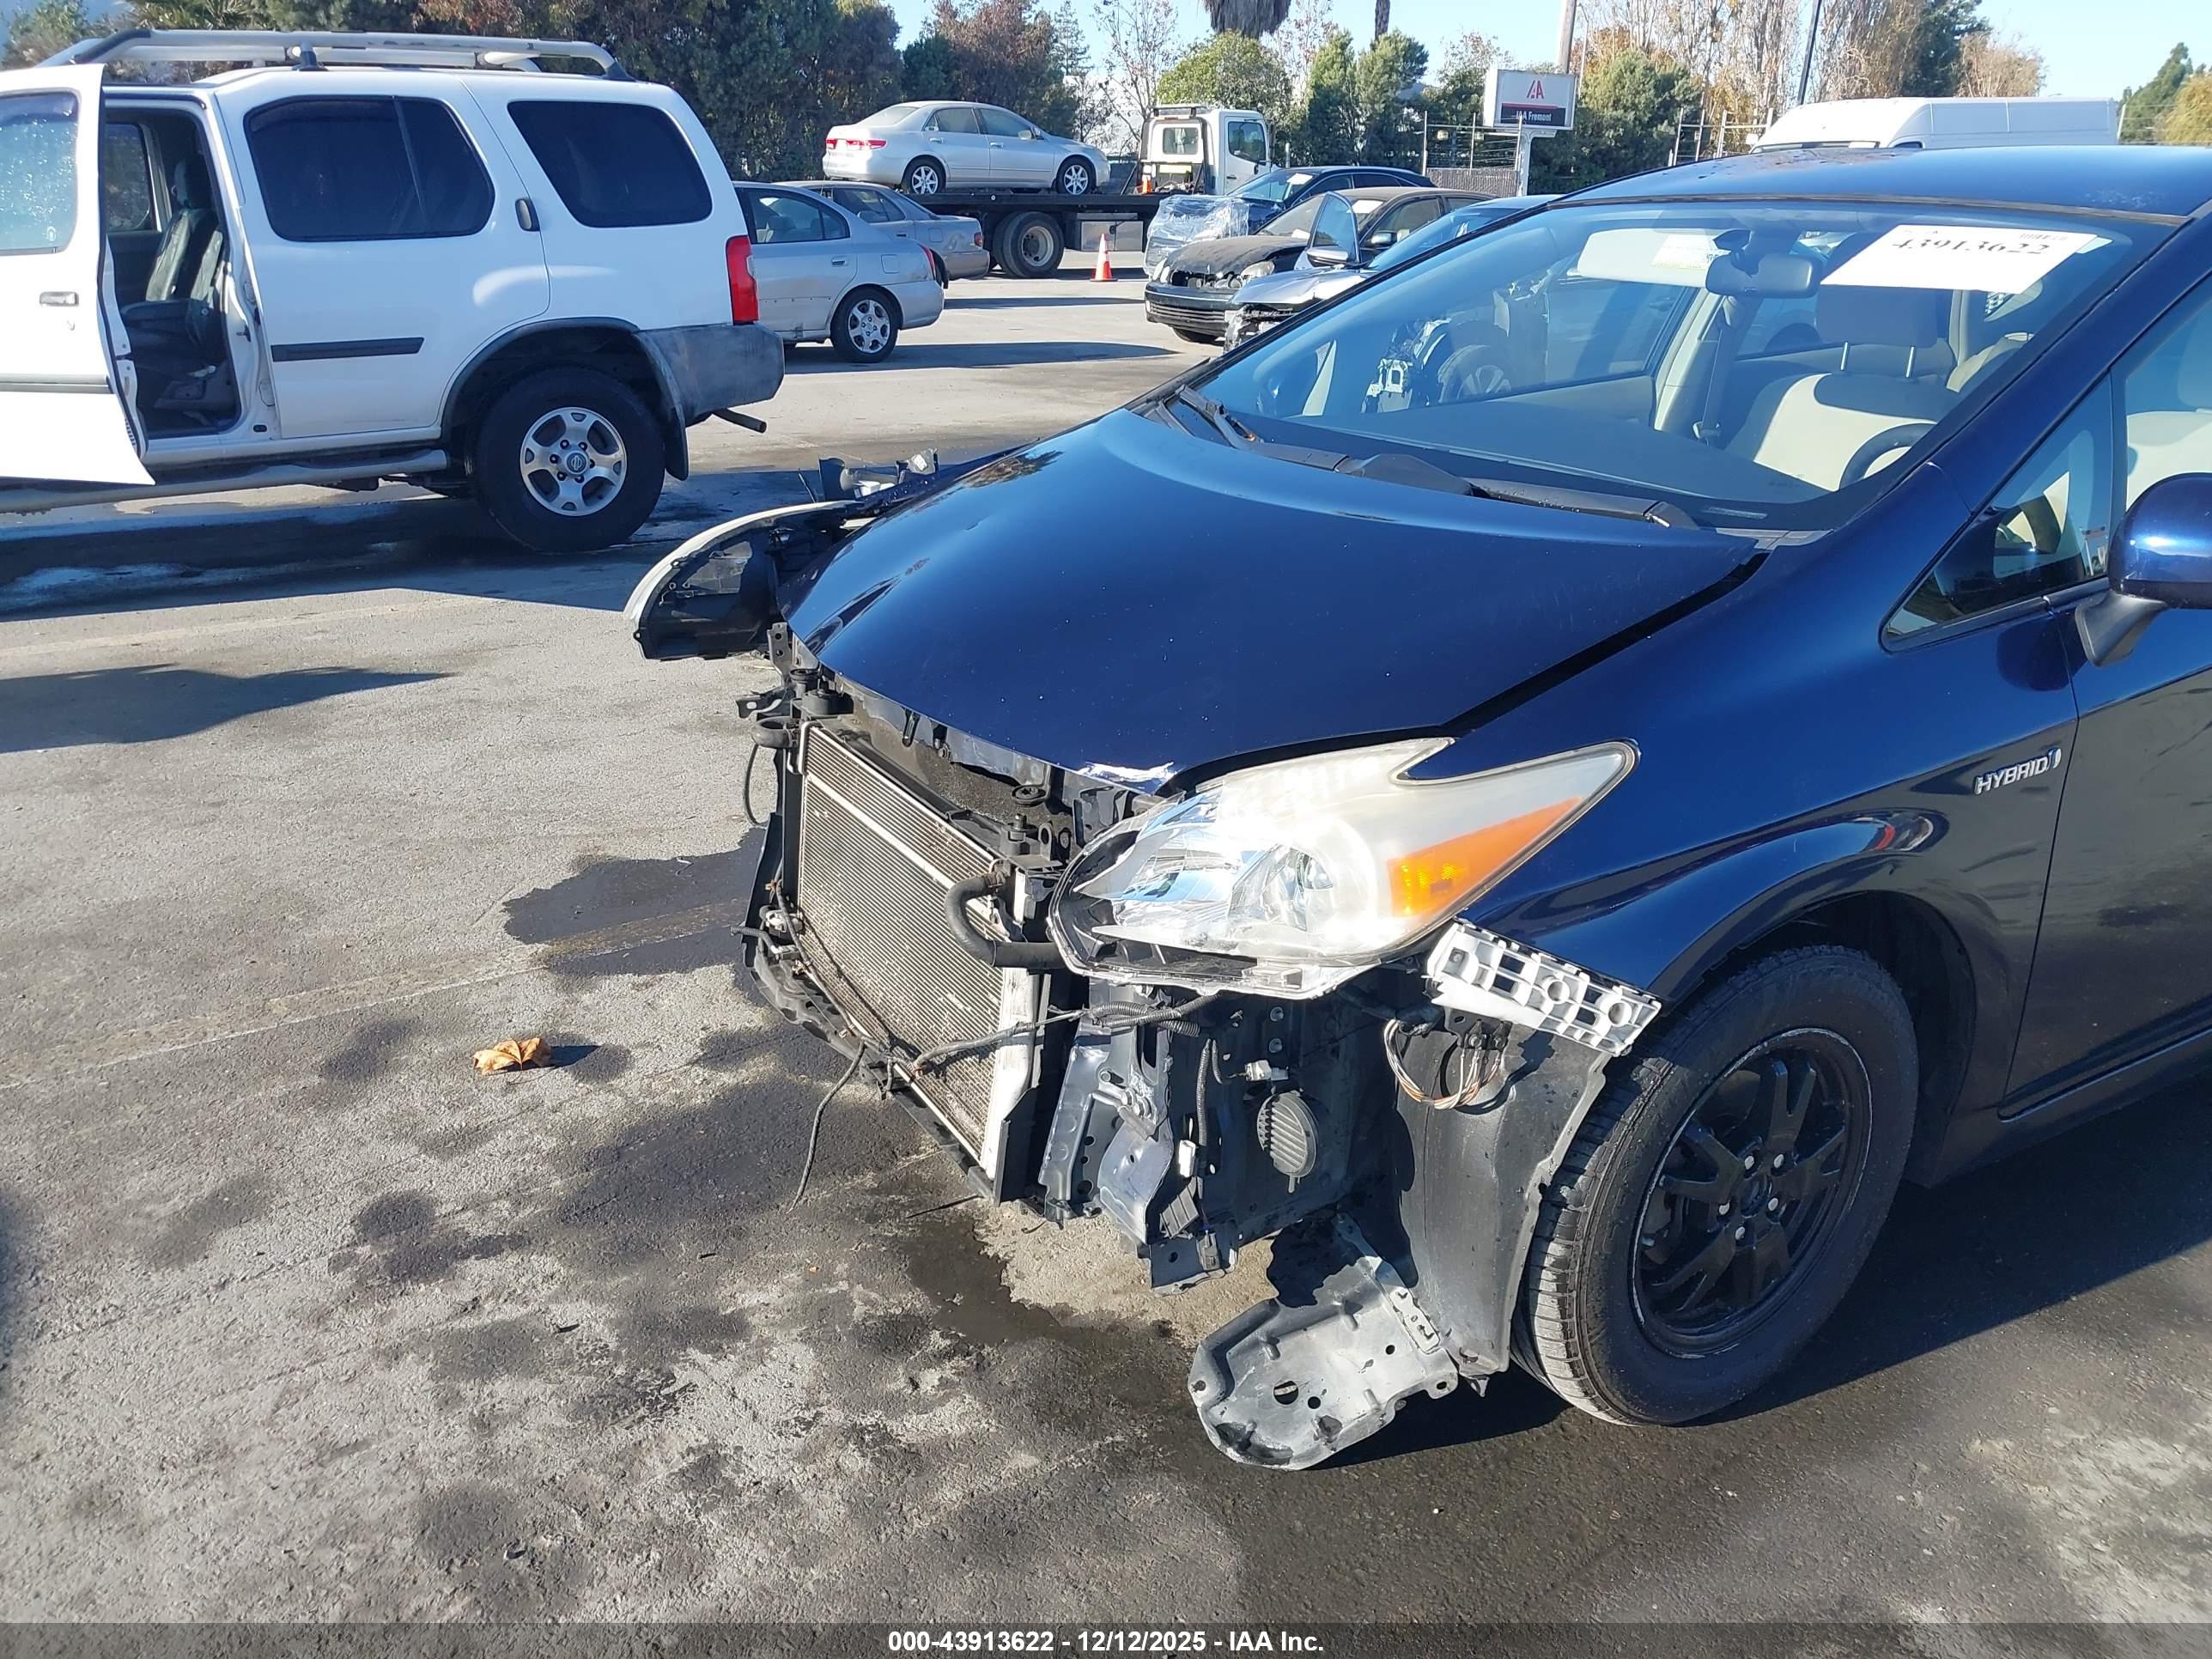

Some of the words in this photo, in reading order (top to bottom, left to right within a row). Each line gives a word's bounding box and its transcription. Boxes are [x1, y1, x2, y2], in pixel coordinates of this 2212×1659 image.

[1528, 111, 1553, 122] Fremont
[1892, 238, 2051, 255] 43913622
[1973, 755, 2051, 796] HYBRID
